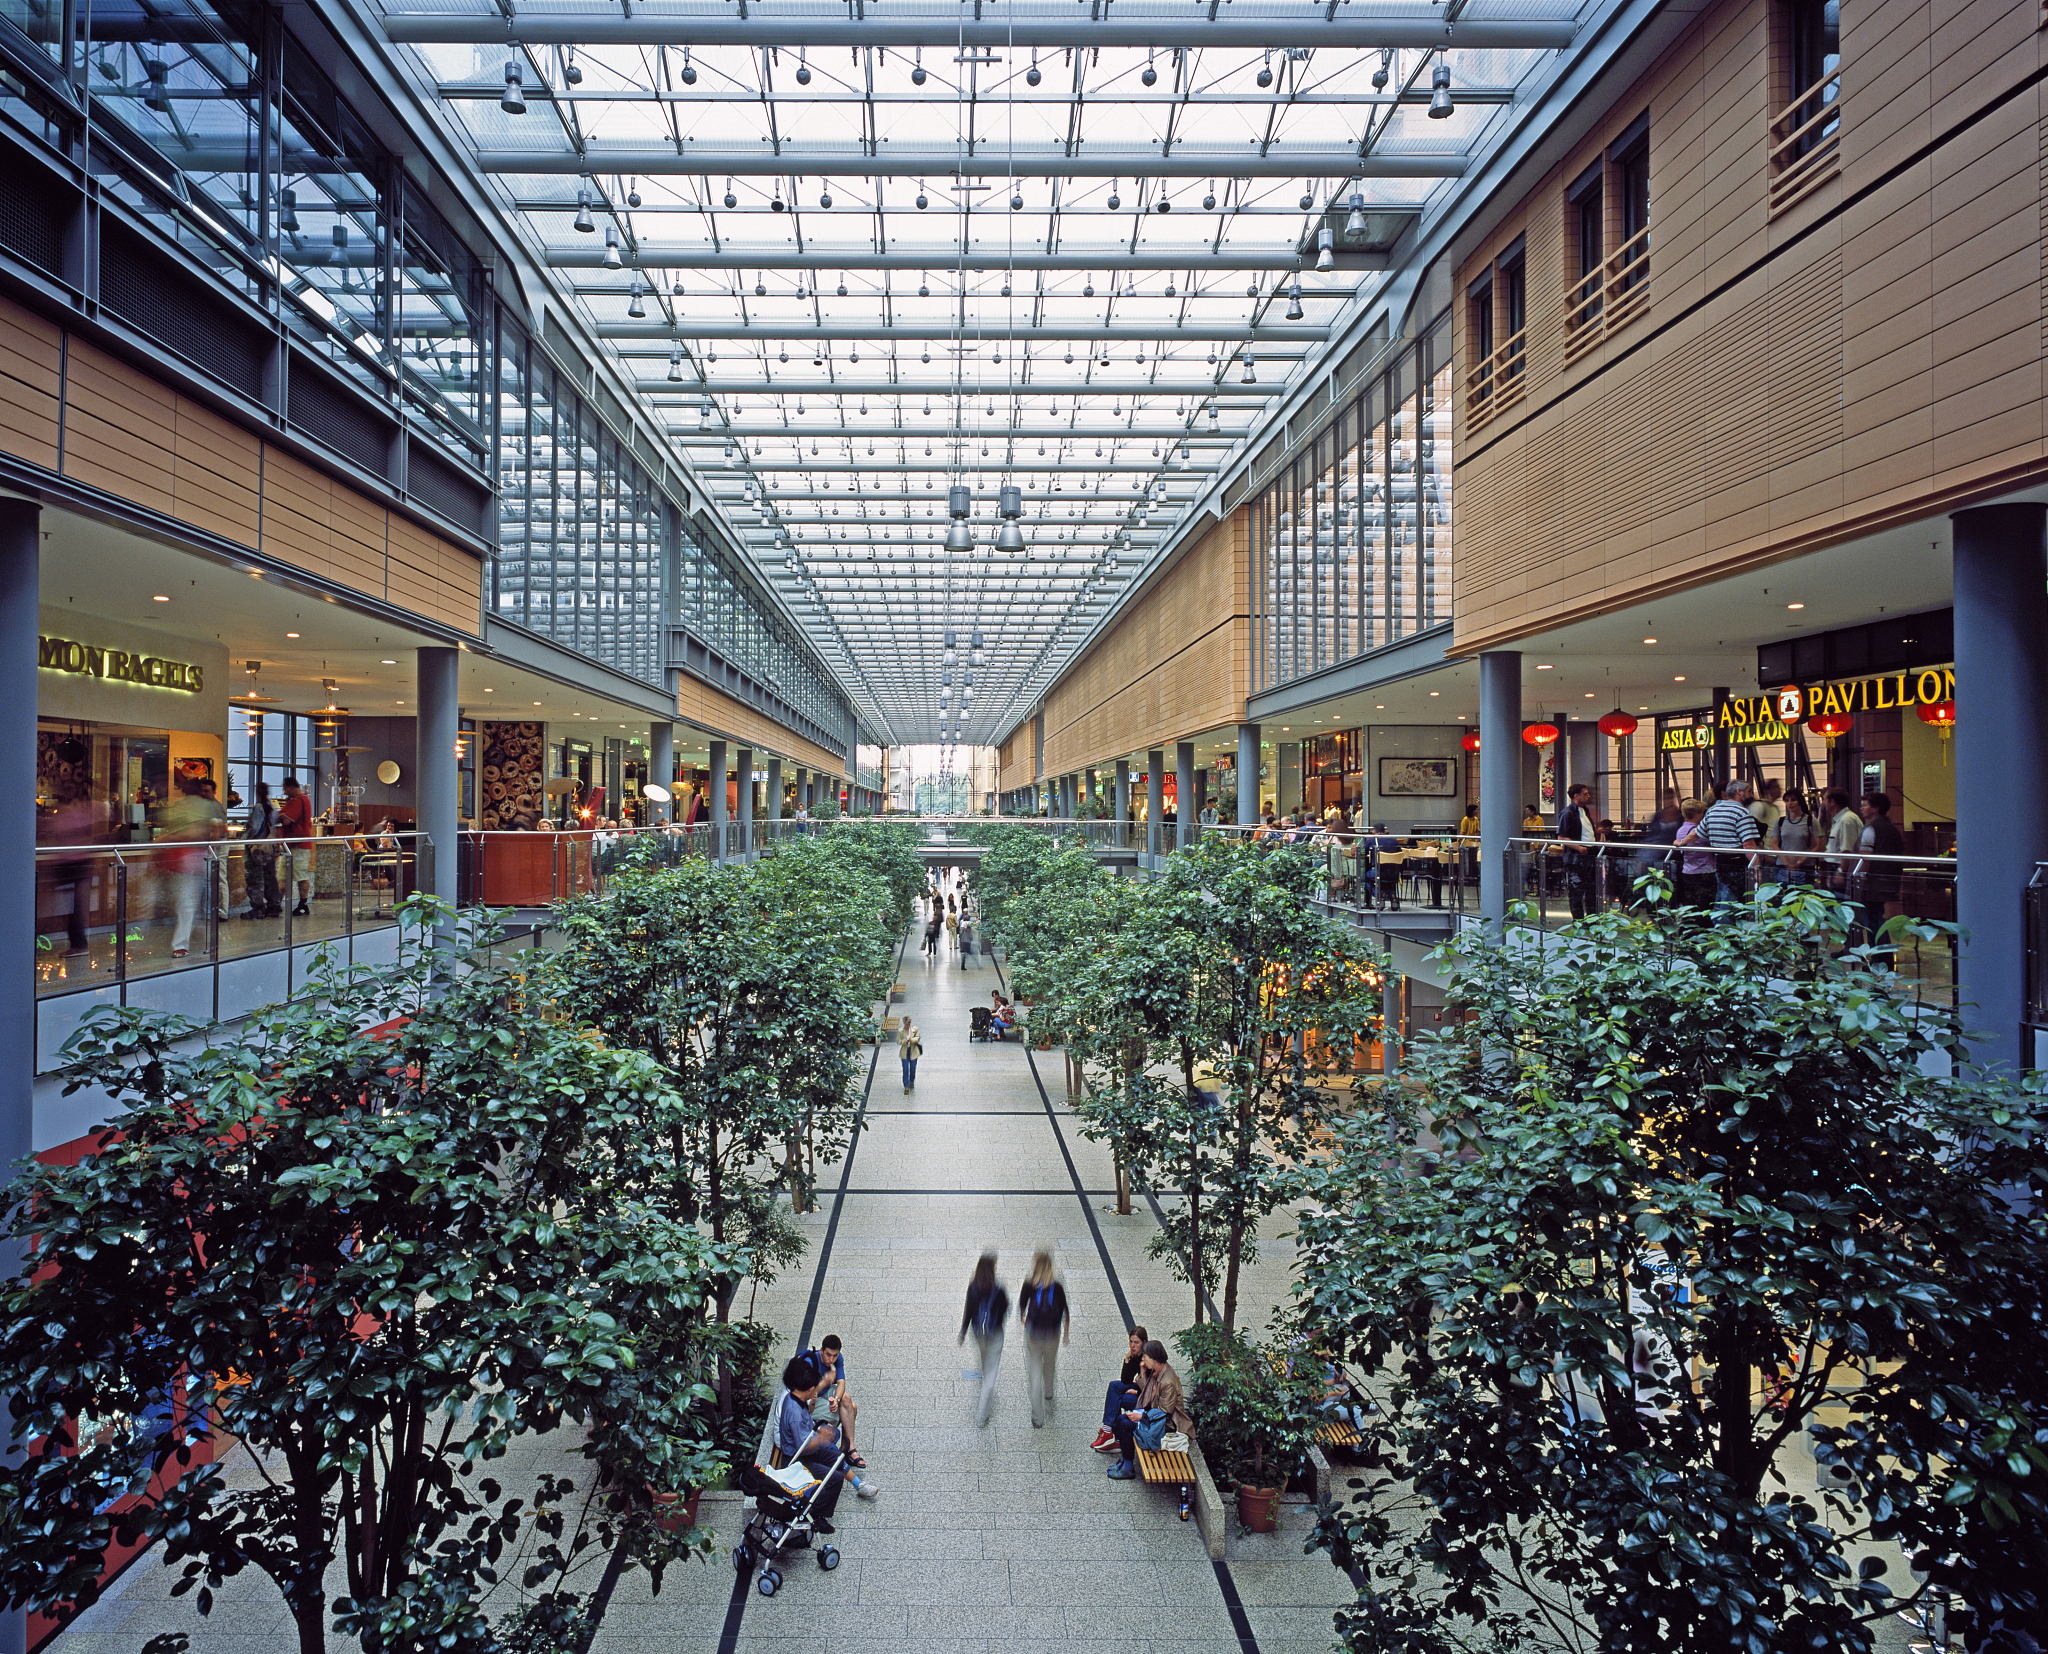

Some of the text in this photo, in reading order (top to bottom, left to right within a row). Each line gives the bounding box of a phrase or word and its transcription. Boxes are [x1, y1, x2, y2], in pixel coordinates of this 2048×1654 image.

[106, 649, 204, 693] BAGELS
[1719, 695, 1774, 728] ASIA
[1662, 729, 1694, 749] ASIA
